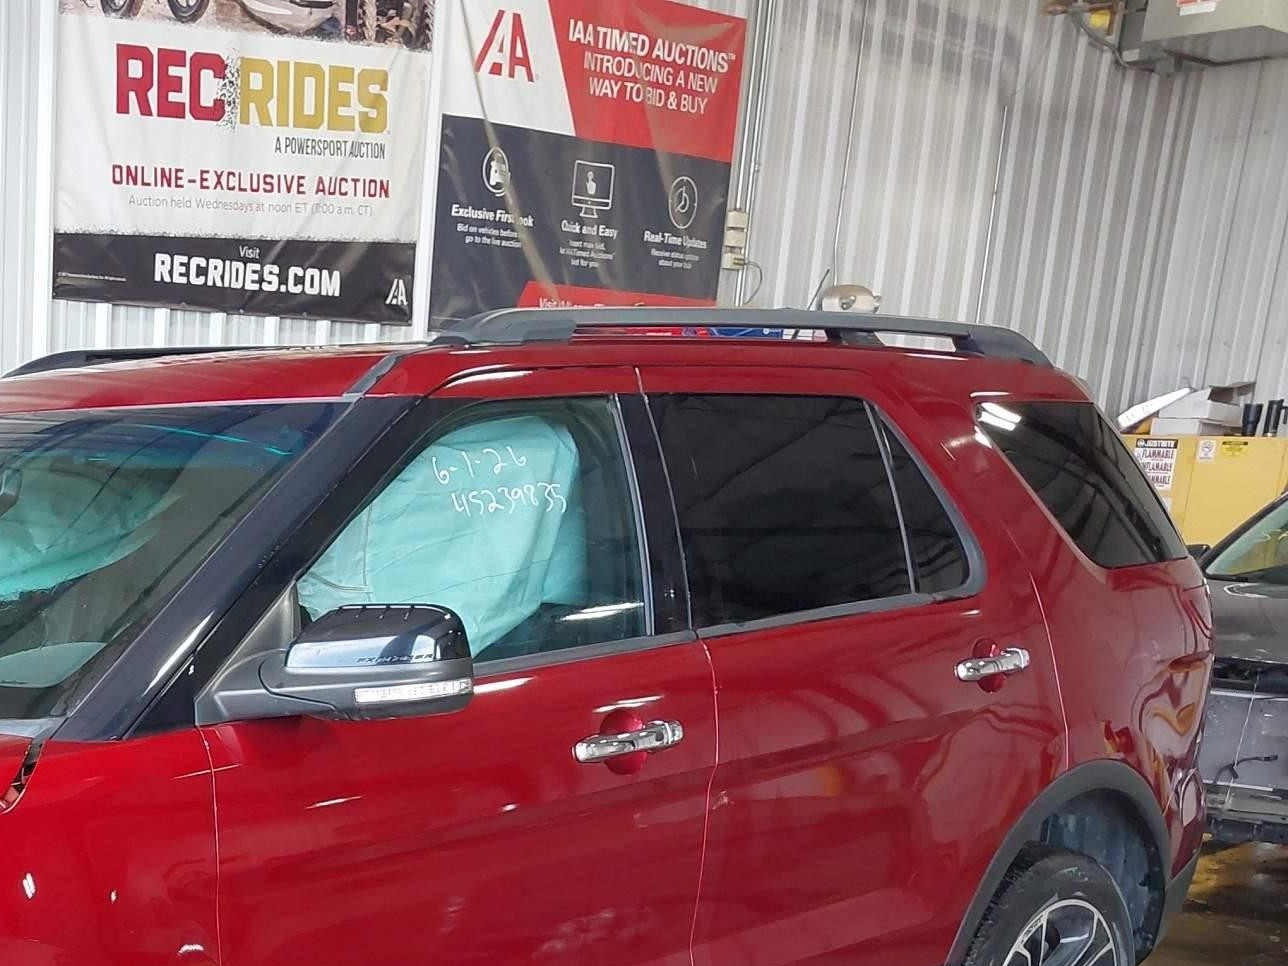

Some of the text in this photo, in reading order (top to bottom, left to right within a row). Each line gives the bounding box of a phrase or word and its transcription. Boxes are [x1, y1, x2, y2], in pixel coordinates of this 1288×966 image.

[568, 19, 594, 46] IAA
[597, 26, 650, 57] TIMED
[584, 51, 718, 94] INTRODUCING A NEW
[589, 77, 708, 115] WAY TO BID & BUY
[274, 137, 386, 160] A POWERSPORT AUCTION
[111, 164, 391, 198] ONLINE-EXCLUSIVE AUCTION
[129, 195, 168, 208] Auction
[170, 197, 191, 209] held
[195, 198, 254, 213] Wednesdays
[255, 203, 265, 212] at
[268, 203, 292, 213] noon
[295, 203, 308, 213] ET
[451, 204, 495, 221] Exclusive
[561, 220, 619, 240] Quick and Easy
[644, 230, 682, 246] Real-Time
[238, 246, 260, 259] Visit
[154, 253, 341, 297] RECRIDES.COM
[432, 446, 527, 485] 6-1-26
